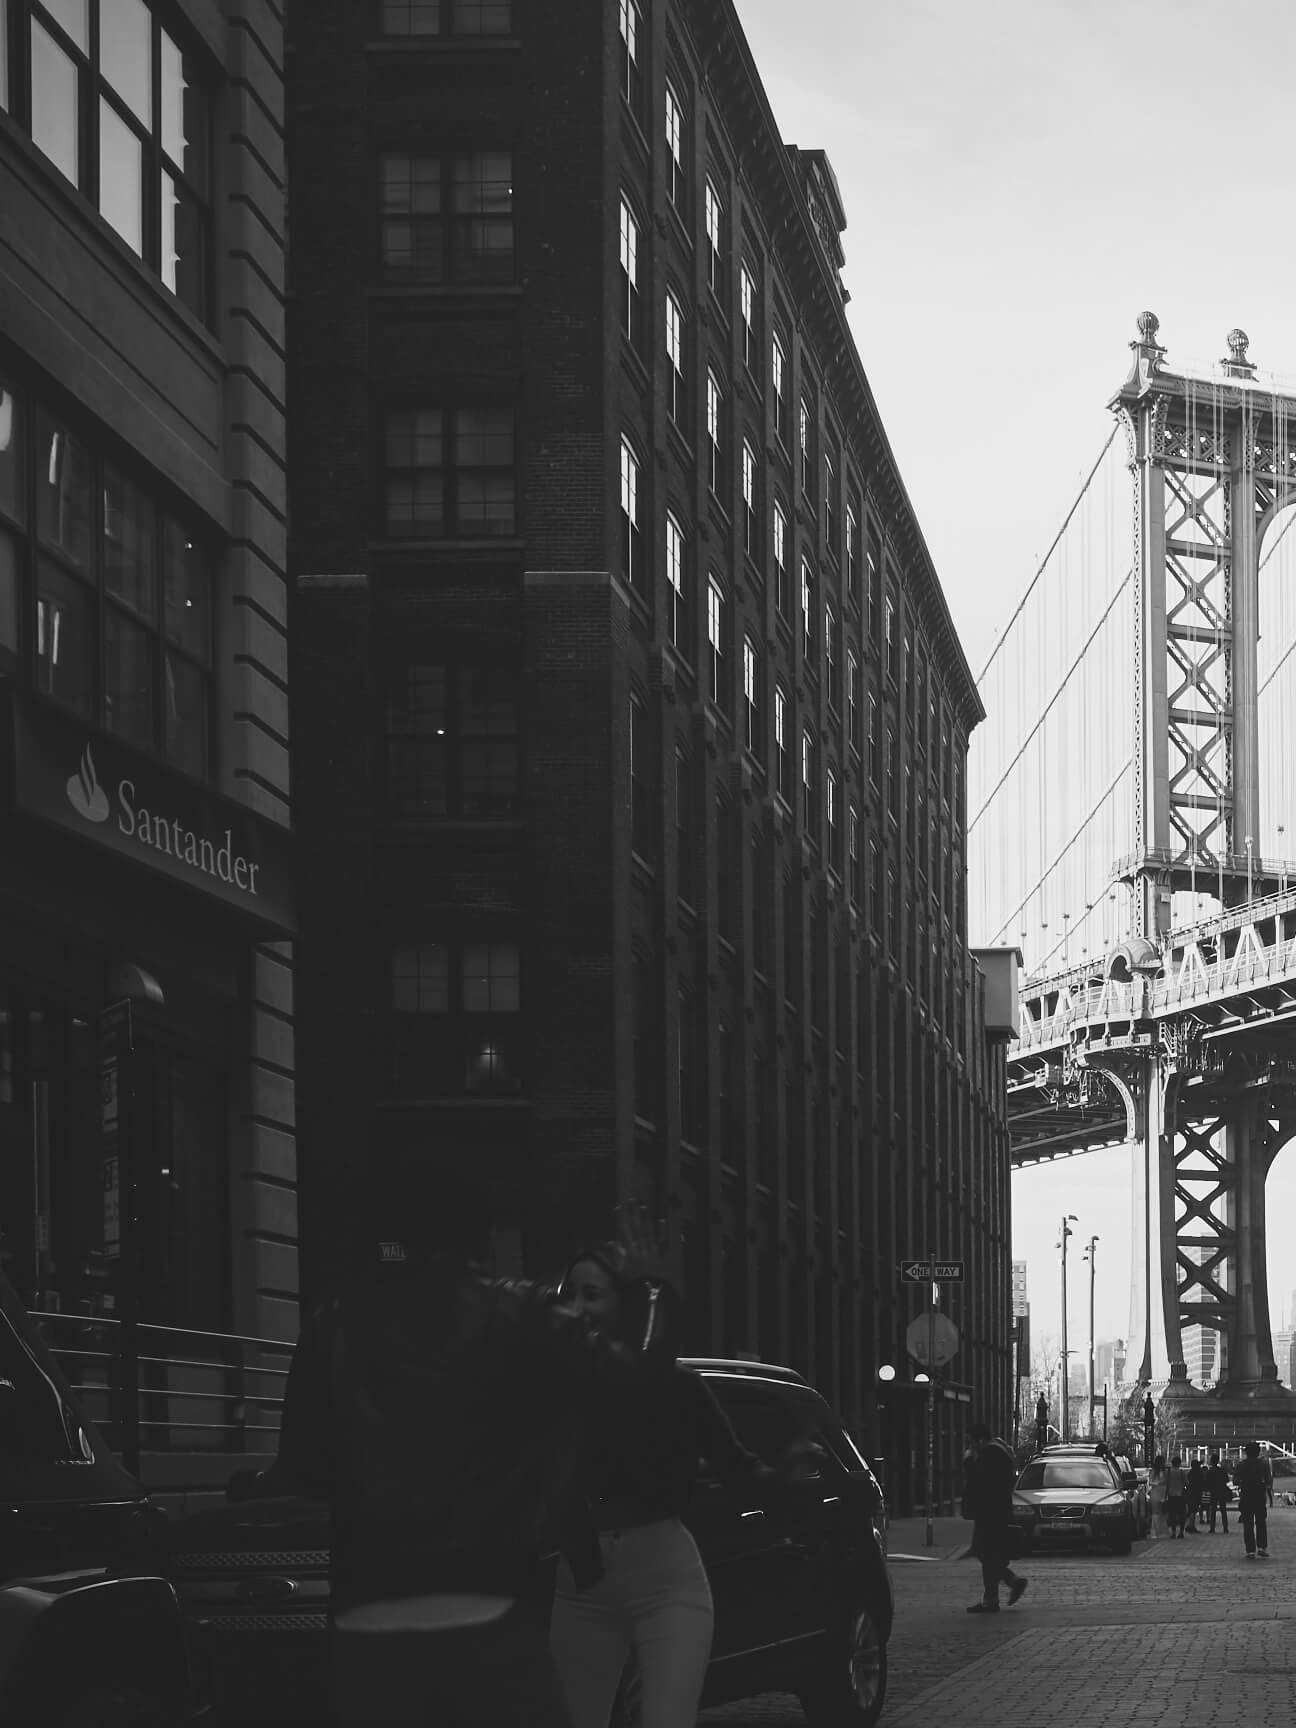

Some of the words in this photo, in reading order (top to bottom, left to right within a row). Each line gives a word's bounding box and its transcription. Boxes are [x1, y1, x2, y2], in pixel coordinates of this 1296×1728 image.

[118, 779, 260, 895] Santander
[911, 1267, 929, 1276] ONE
[936, 1267, 956, 1276] WAY
